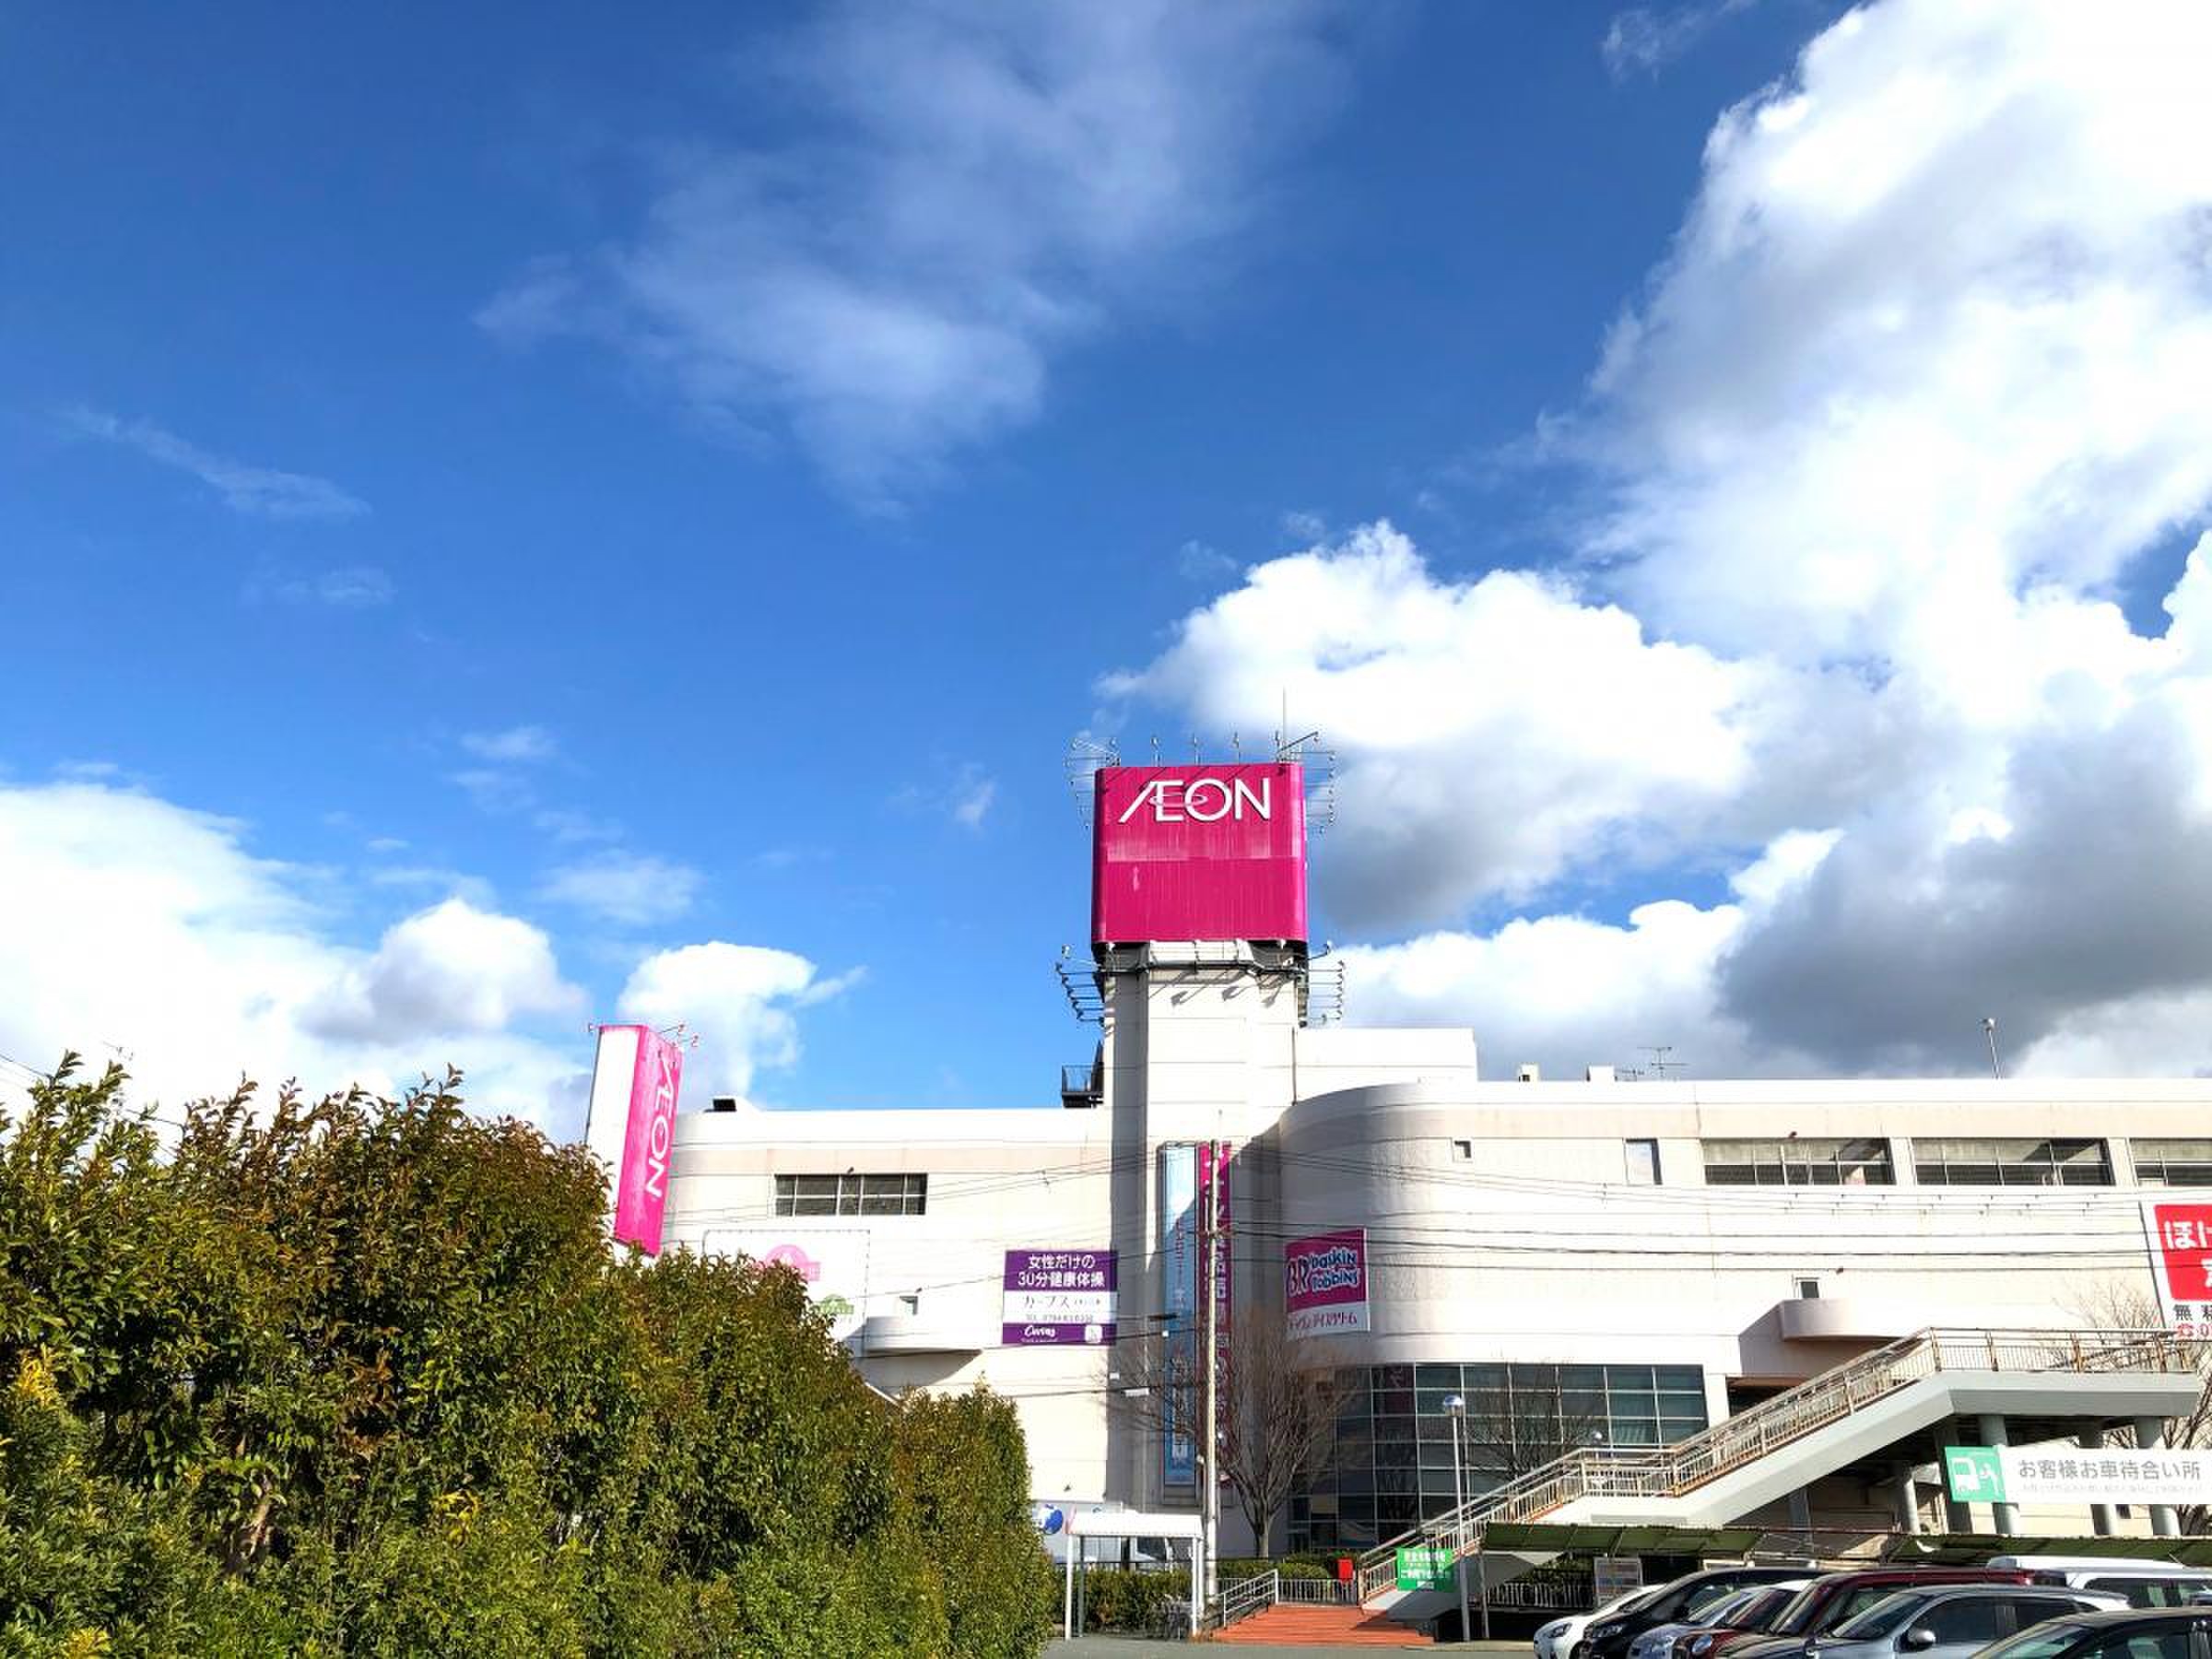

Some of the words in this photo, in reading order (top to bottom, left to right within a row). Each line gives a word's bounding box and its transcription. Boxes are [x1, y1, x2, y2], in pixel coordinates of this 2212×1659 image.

[1028, 1254, 1095, 1269] 女性だけの
[1018, 1271, 1105, 1288] 30分健康体操
[2018, 1459, 2201, 1480] お客様お車待合い所
